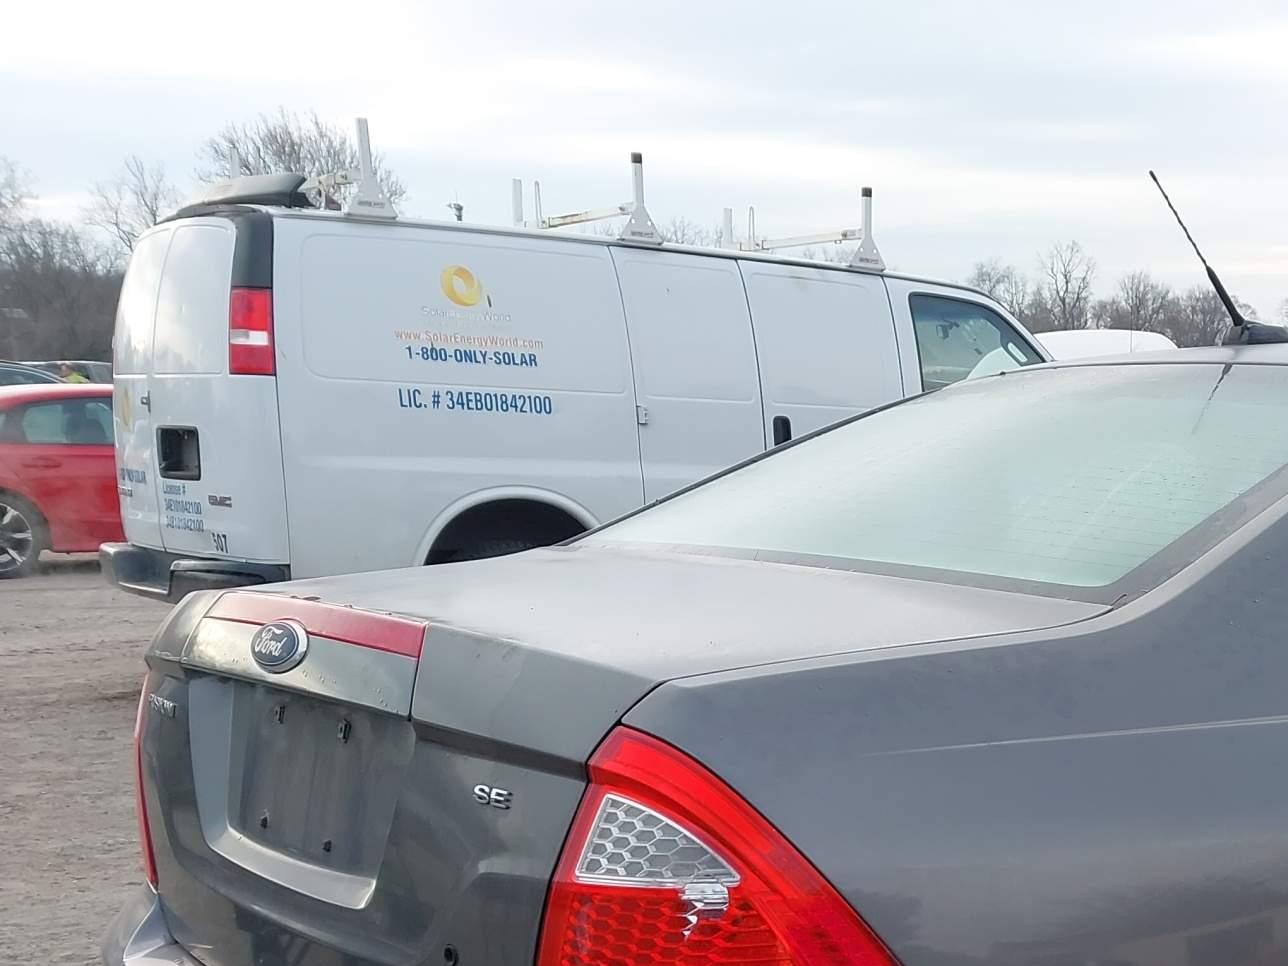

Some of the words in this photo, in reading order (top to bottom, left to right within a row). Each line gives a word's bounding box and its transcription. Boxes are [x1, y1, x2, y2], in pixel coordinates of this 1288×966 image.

[394, 329, 543, 350] www.SolarEnergyWorld.com
[405, 345, 538, 367] 1-800-ONLY-SOLAR
[398, 387, 428, 409] LIC.
[432, 390, 441, 409] #
[445, 390, 553, 415] 34EB01842100
[254, 626, 288, 657] Ford
[473, 784, 510, 809] SE
